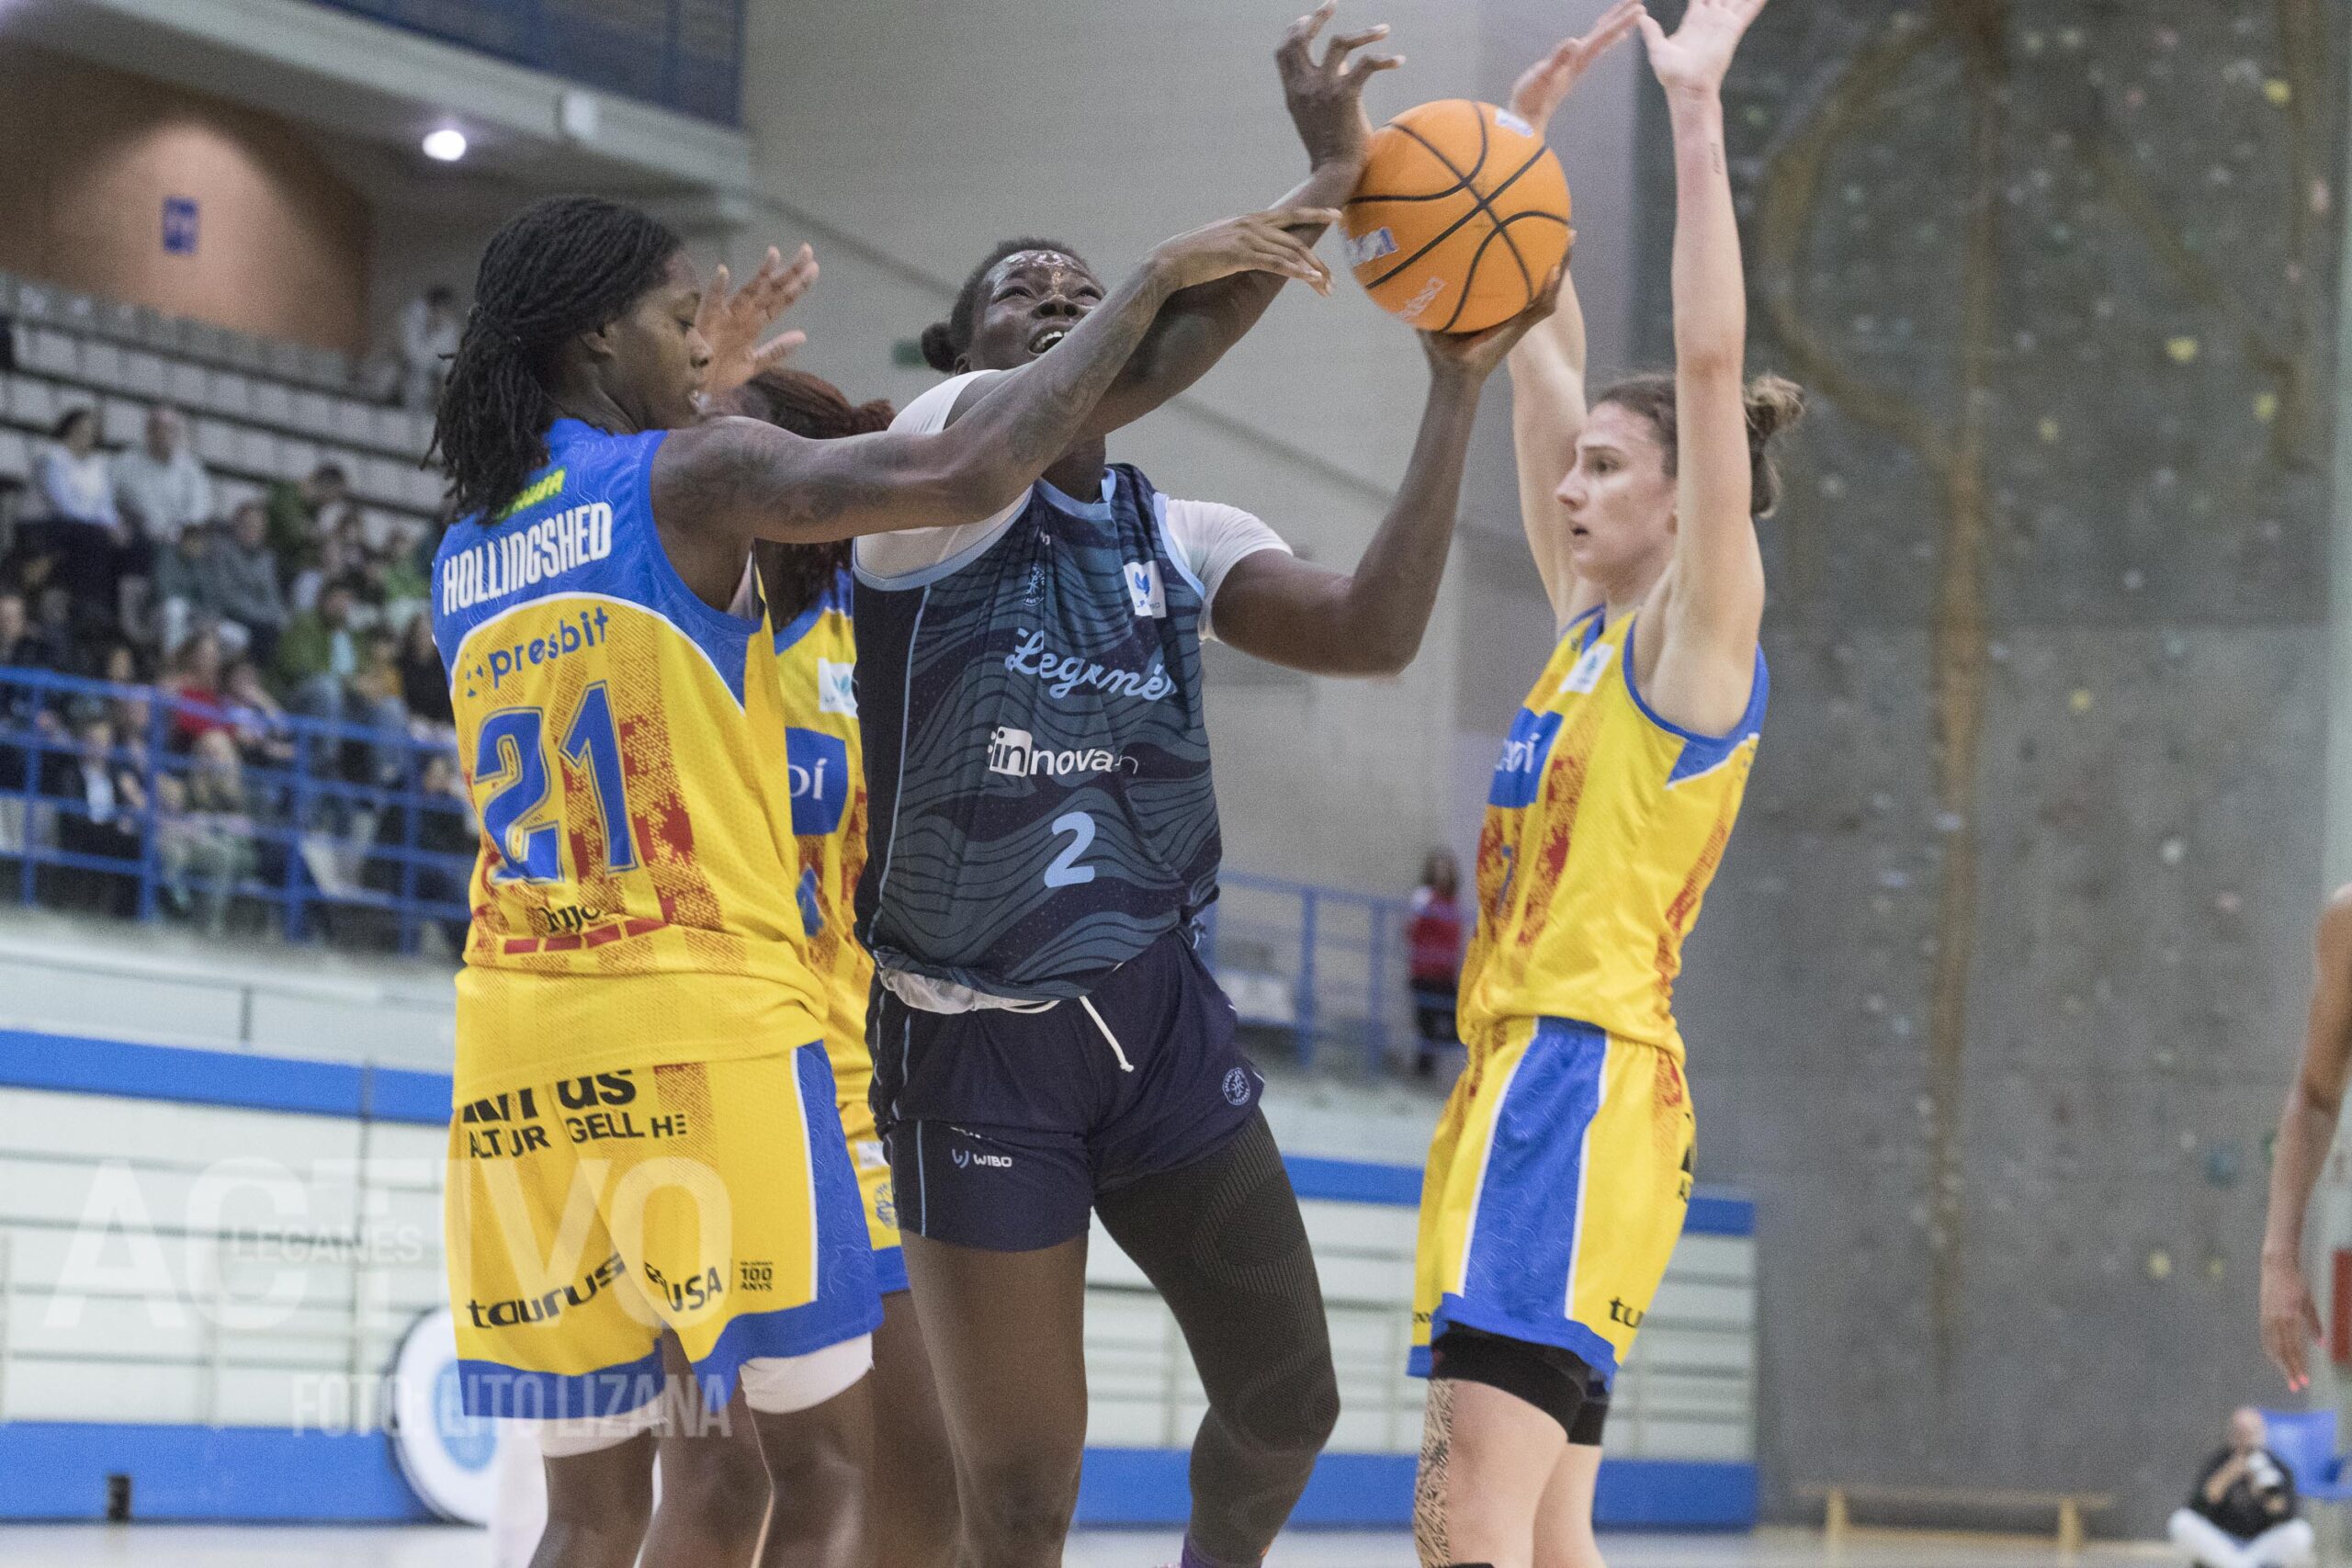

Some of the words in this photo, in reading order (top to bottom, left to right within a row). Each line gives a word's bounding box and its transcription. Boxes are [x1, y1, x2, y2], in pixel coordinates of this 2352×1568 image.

[442, 502, 613, 615] HOLLINGSHED
[473, 681, 639, 885] 21
[1044, 811, 1095, 888] 2
[468, 1251, 627, 1328] taurus
[740, 1268, 773, 1280] 100
